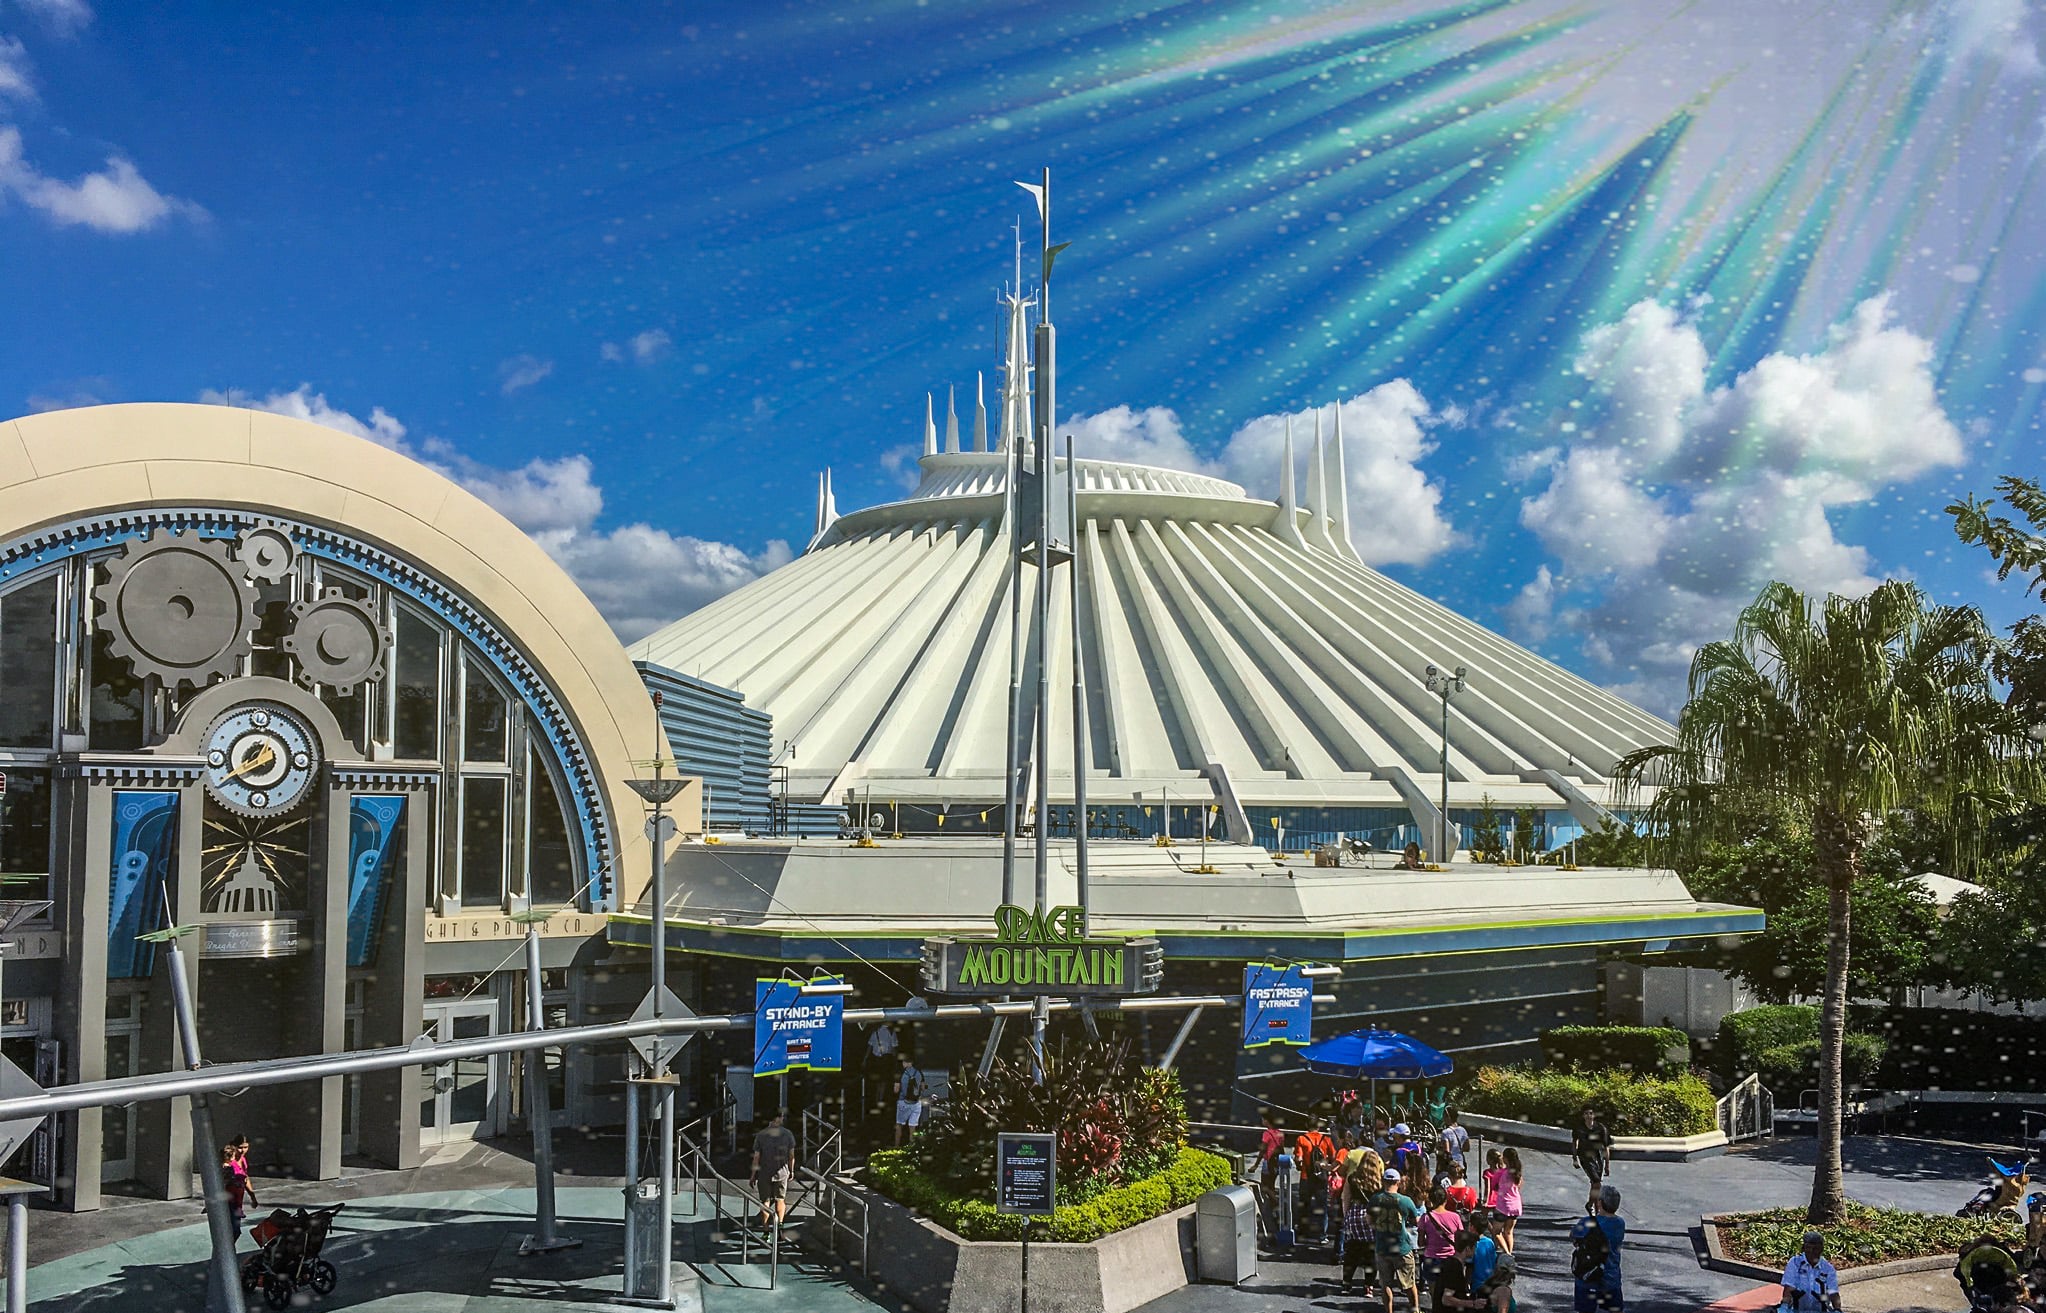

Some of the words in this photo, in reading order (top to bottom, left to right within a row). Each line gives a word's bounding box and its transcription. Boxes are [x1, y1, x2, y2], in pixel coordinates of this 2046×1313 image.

[472, 922, 480, 937] &
[493, 919, 550, 936] POWR
[564, 918, 588, 934] CO.
[994, 903, 1087, 945] SPACE
[959, 945, 1124, 988] MOUNTAIN
[1249, 987, 1309, 1000] FASTPASS+
[1258, 998, 1300, 1009] ENTRANCE
[766, 1005, 832, 1020] STAND-BY
[772, 1019, 826, 1031] ENTRANCE
